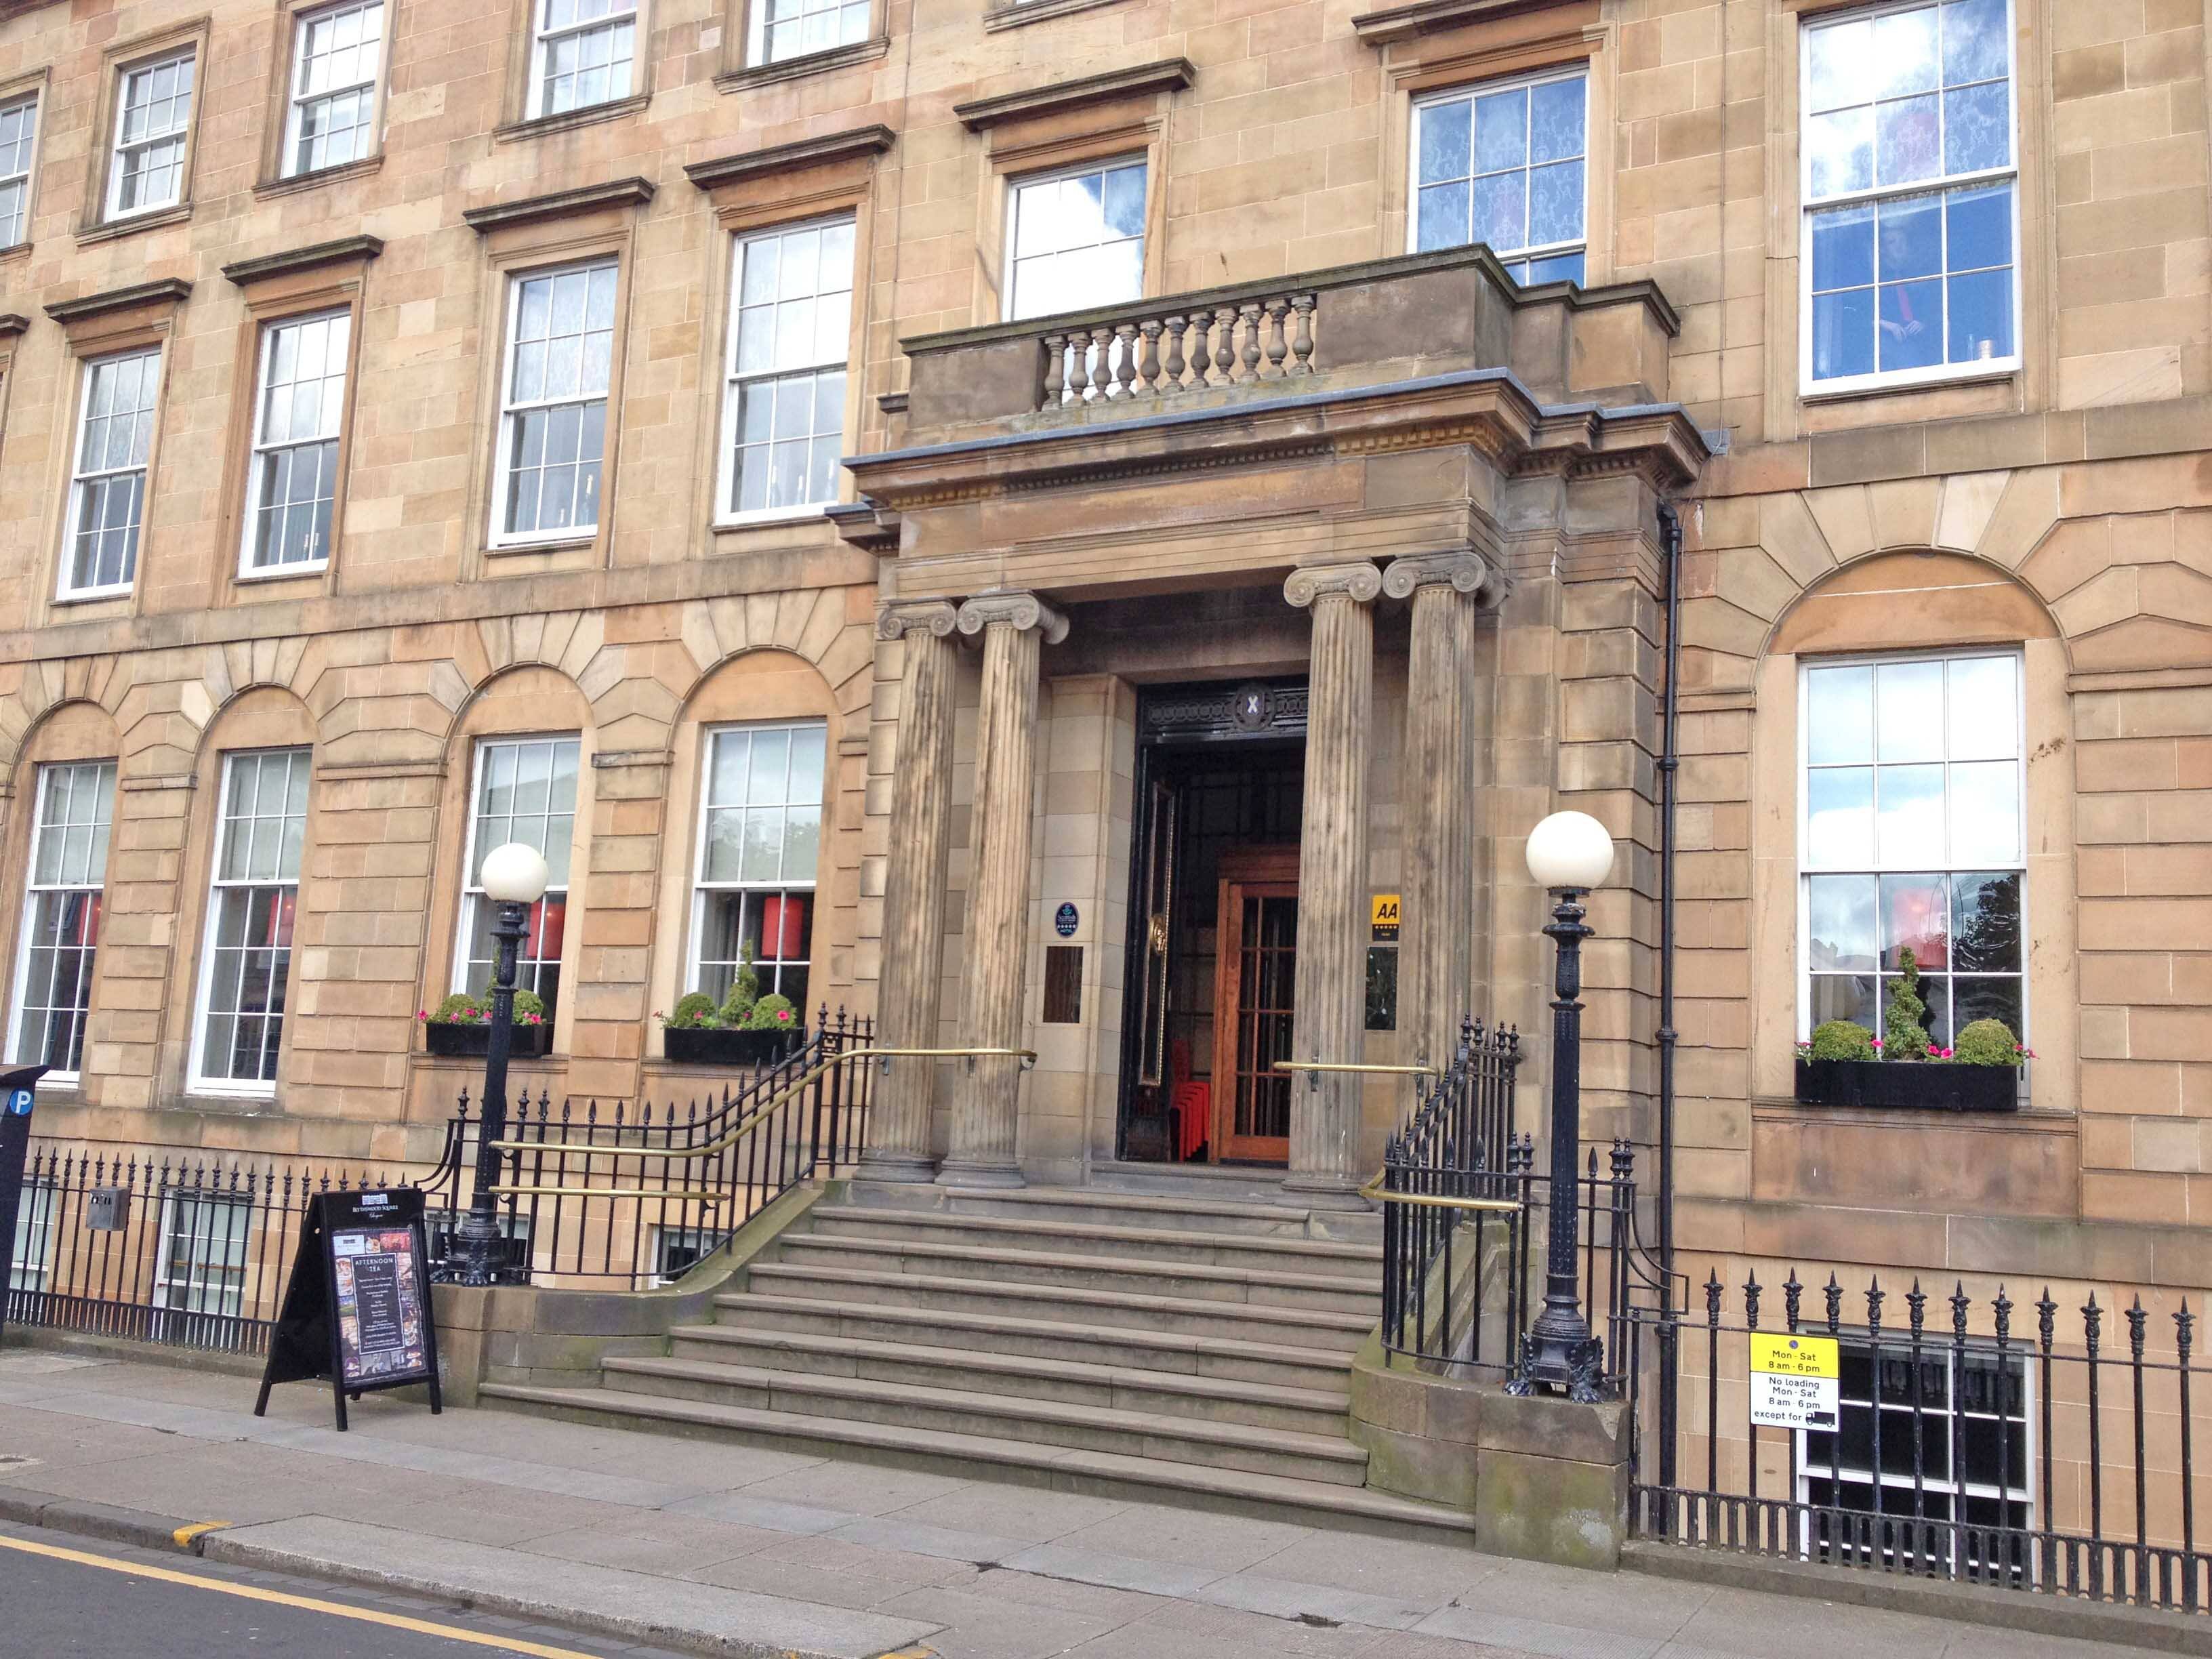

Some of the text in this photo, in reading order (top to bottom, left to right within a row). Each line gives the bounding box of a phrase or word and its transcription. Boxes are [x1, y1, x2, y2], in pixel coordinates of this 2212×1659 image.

[1377, 903, 1397, 918] AA
[15, 1090, 31, 1113] P
[1772, 1350, 1792, 1359] Mon
[1800, 1353, 1816, 1361] Sat
[1769, 1377, 1820, 1389] No loading
[1772, 1387, 1792, 1396] Mon
[1800, 1389, 1816, 1398] Sat
[1754, 1411, 1785, 1420] except
